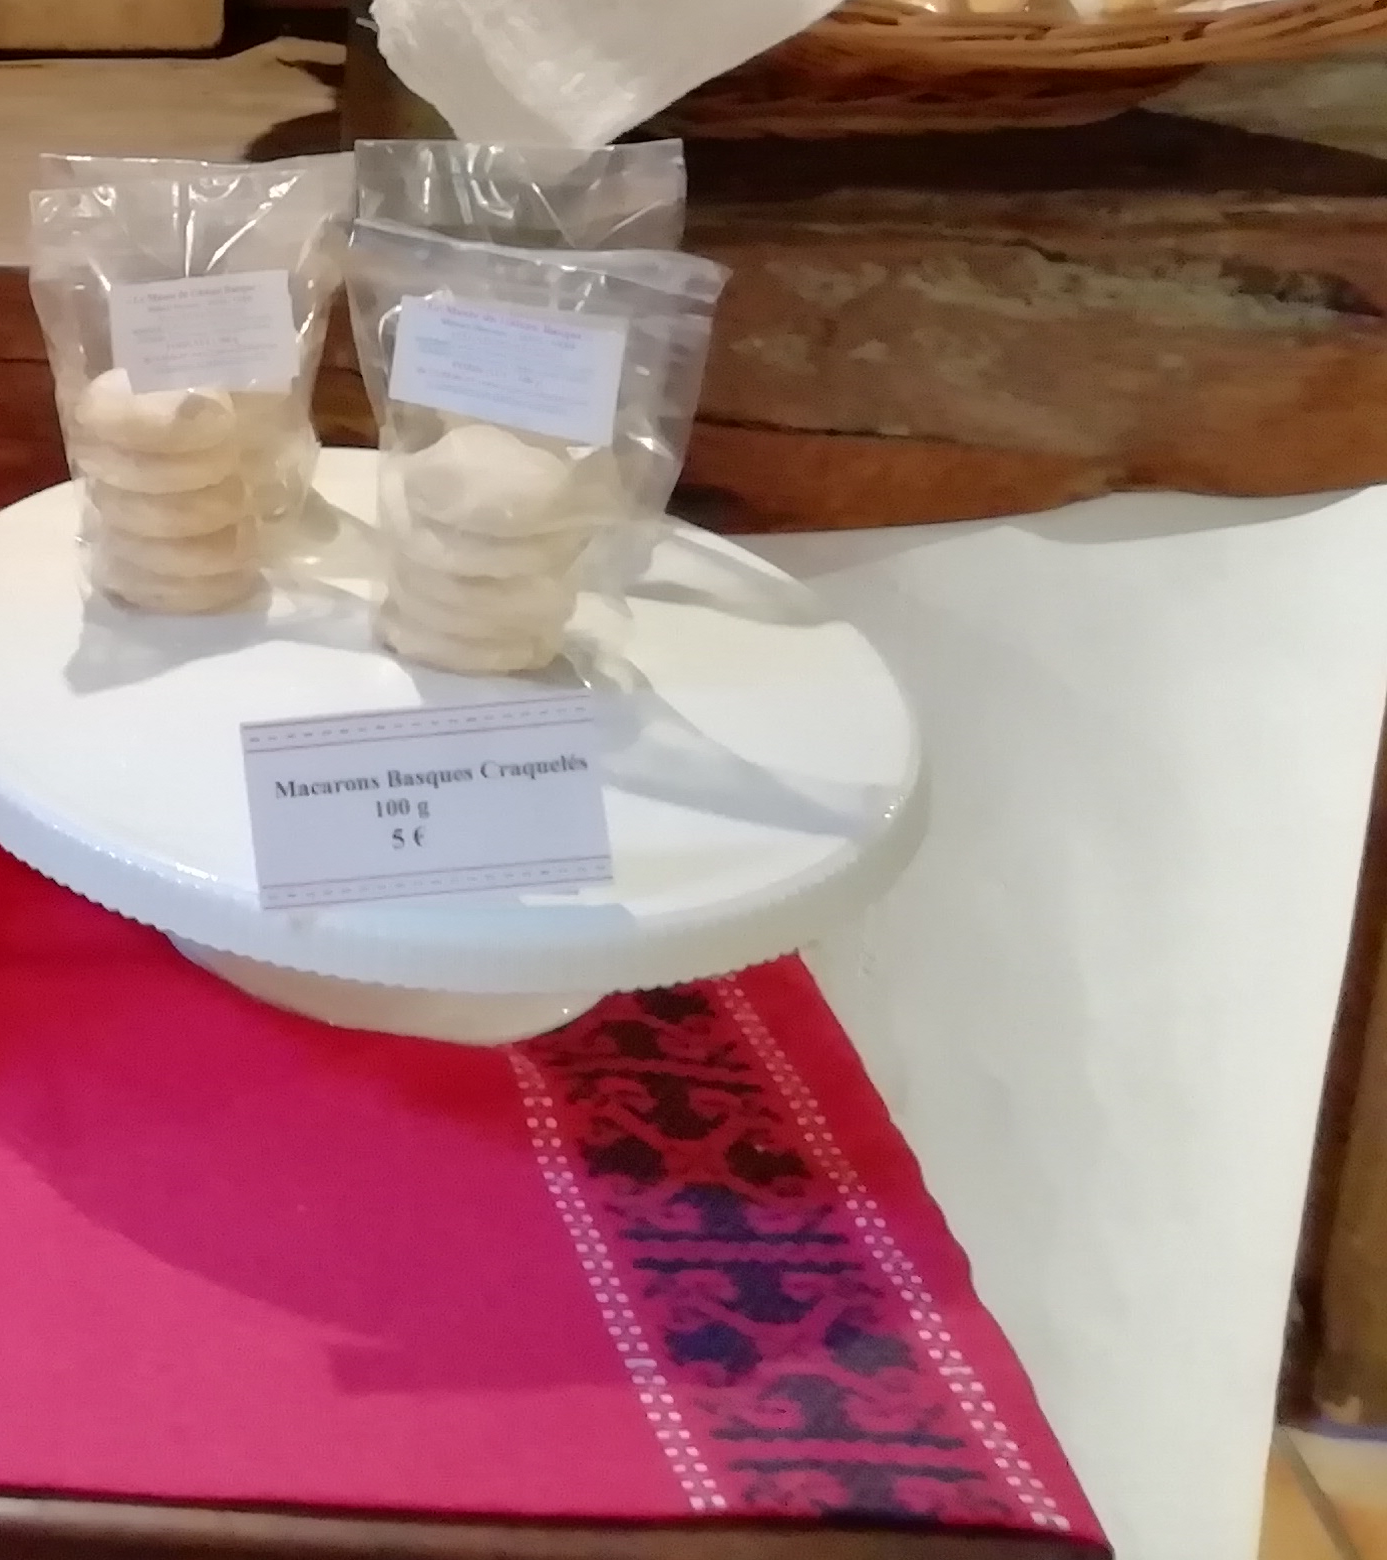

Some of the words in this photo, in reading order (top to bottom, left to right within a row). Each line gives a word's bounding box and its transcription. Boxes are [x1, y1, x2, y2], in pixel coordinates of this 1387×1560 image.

[275, 776, 381, 800] Macarons
[387, 766, 474, 792] Basques
[480, 753, 590, 782] Craquelés
[376, 799, 412, 819] 100
[417, 801, 431, 818] g
[391, 827, 406, 850] 5
[412, 826, 427, 848] €
